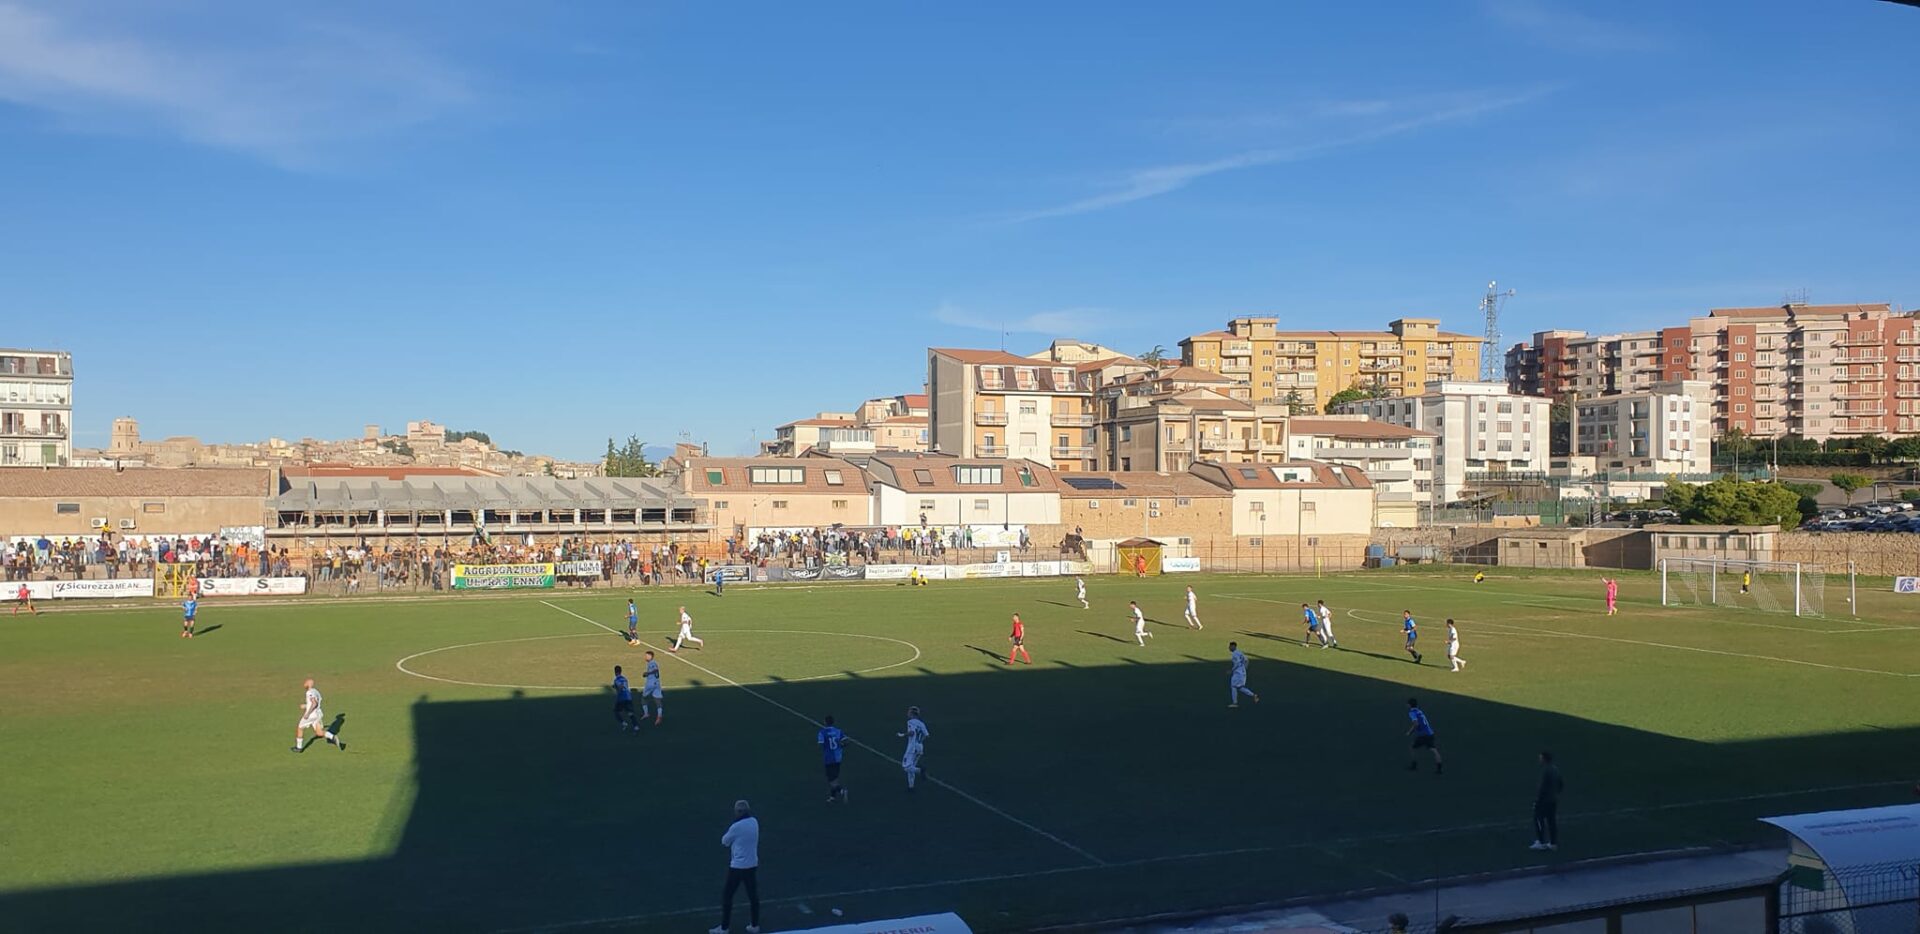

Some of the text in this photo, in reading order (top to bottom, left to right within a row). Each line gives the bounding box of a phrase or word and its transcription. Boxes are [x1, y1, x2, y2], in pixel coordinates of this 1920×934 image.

[464, 565, 545, 575] AGGREGAZIONE
[66, 582, 114, 590] Sicurezza
[466, 576, 545, 587] ULTRAS ENNA
[828, 736, 838, 750] 15
